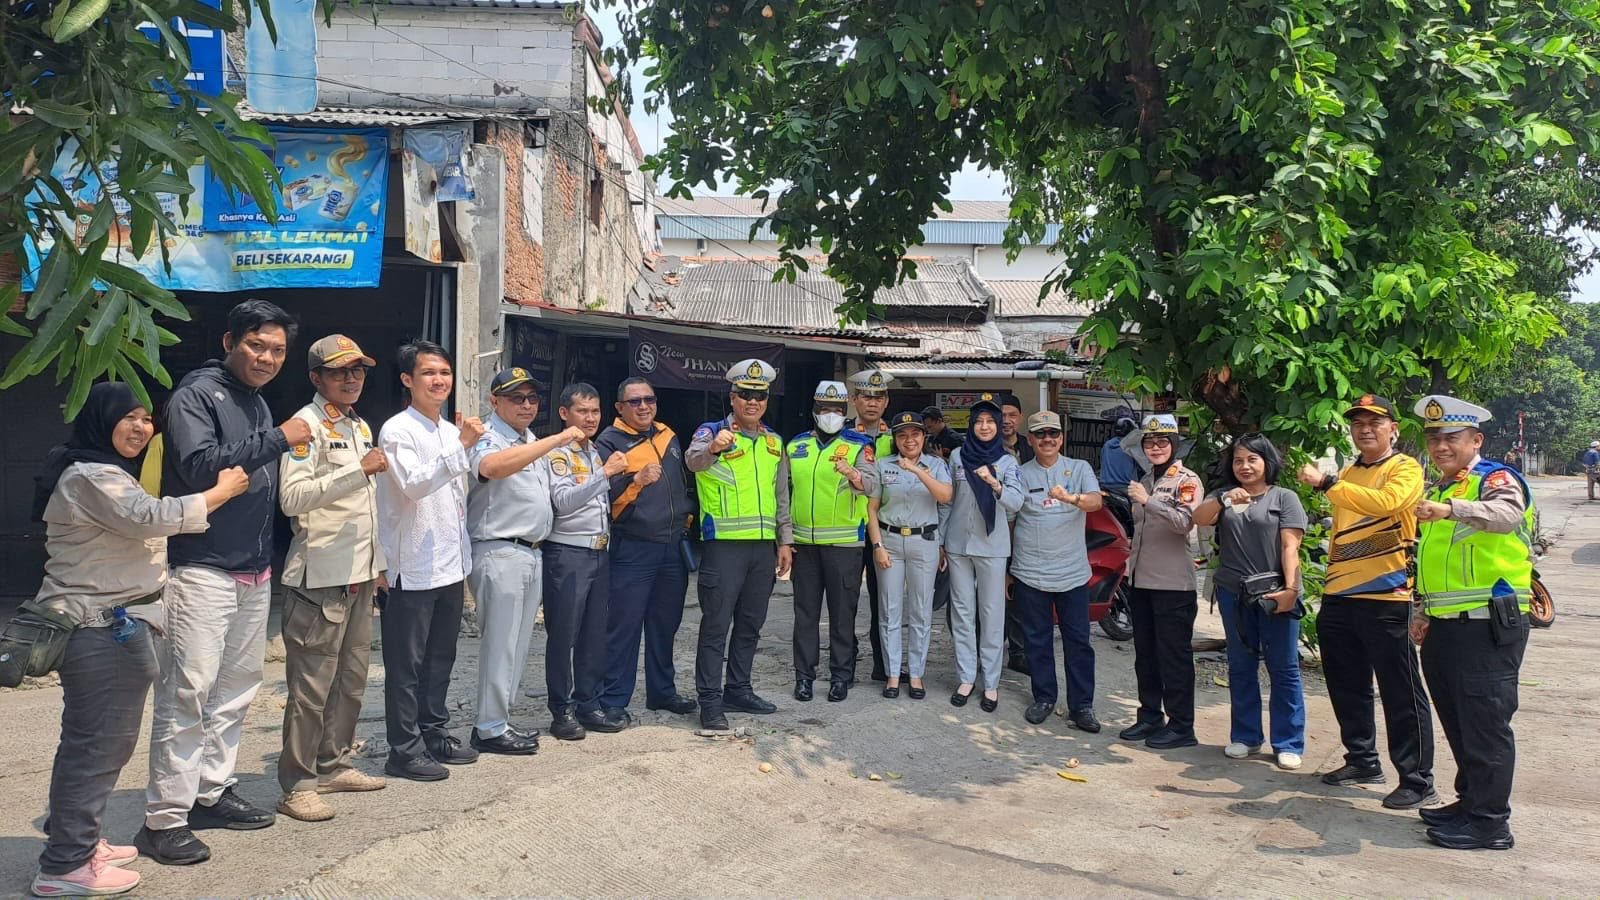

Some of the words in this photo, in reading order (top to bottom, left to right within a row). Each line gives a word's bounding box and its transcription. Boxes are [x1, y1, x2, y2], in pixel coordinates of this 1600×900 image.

[219, 214, 254, 224] Khasnya
[278, 214, 296, 222] Asli
[236, 254, 264, 267] BELI
[267, 253, 347, 265] SEKARANG!
[659, 345, 685, 358] New
